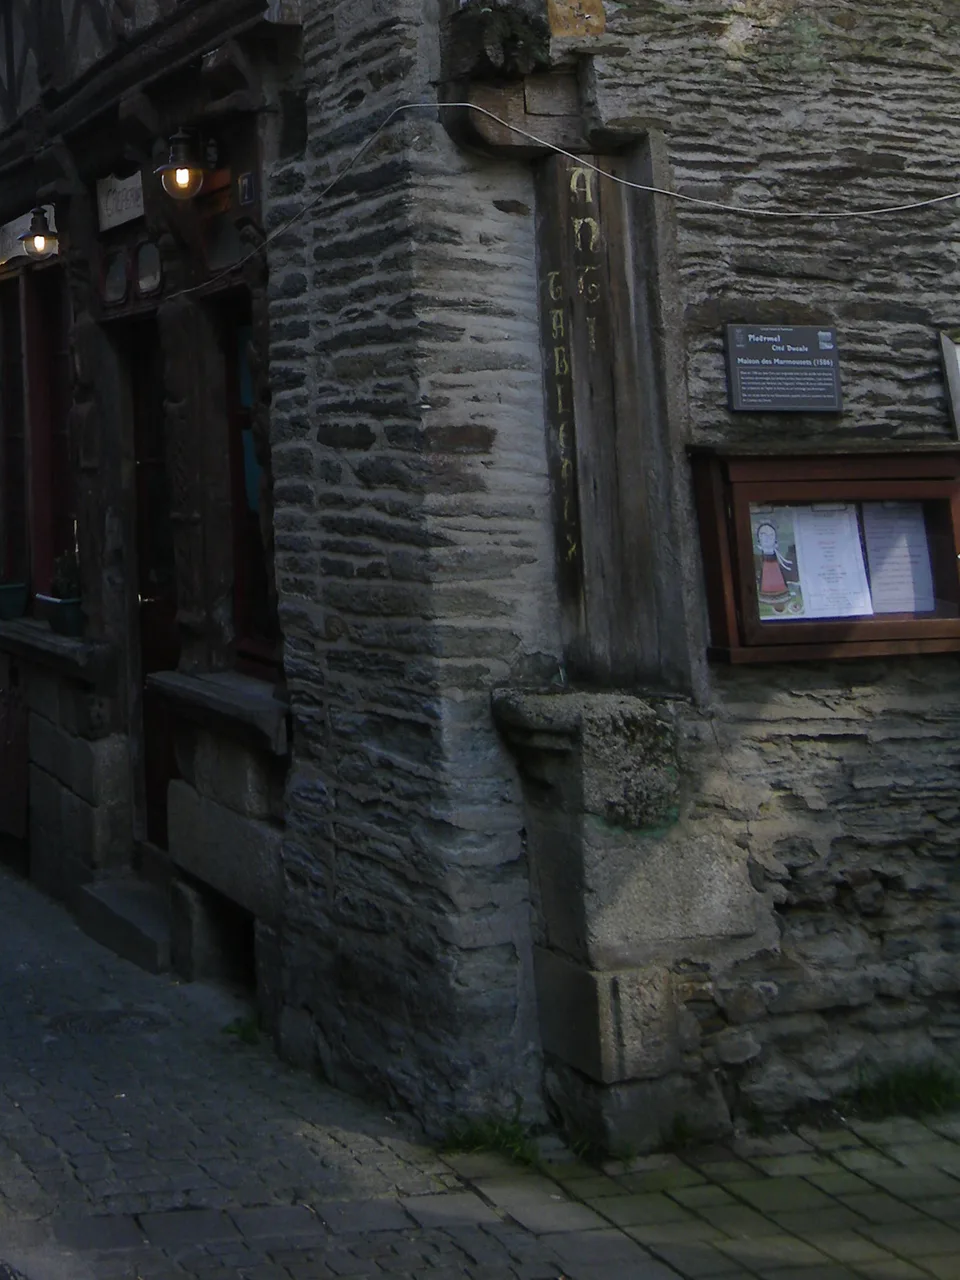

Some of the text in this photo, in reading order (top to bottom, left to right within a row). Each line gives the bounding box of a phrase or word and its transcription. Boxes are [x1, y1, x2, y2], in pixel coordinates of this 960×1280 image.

[748, 334, 781, 342] Ploërmel
[737, 357, 760, 365] Maison
[773, 358, 812, 366] Marmousets
